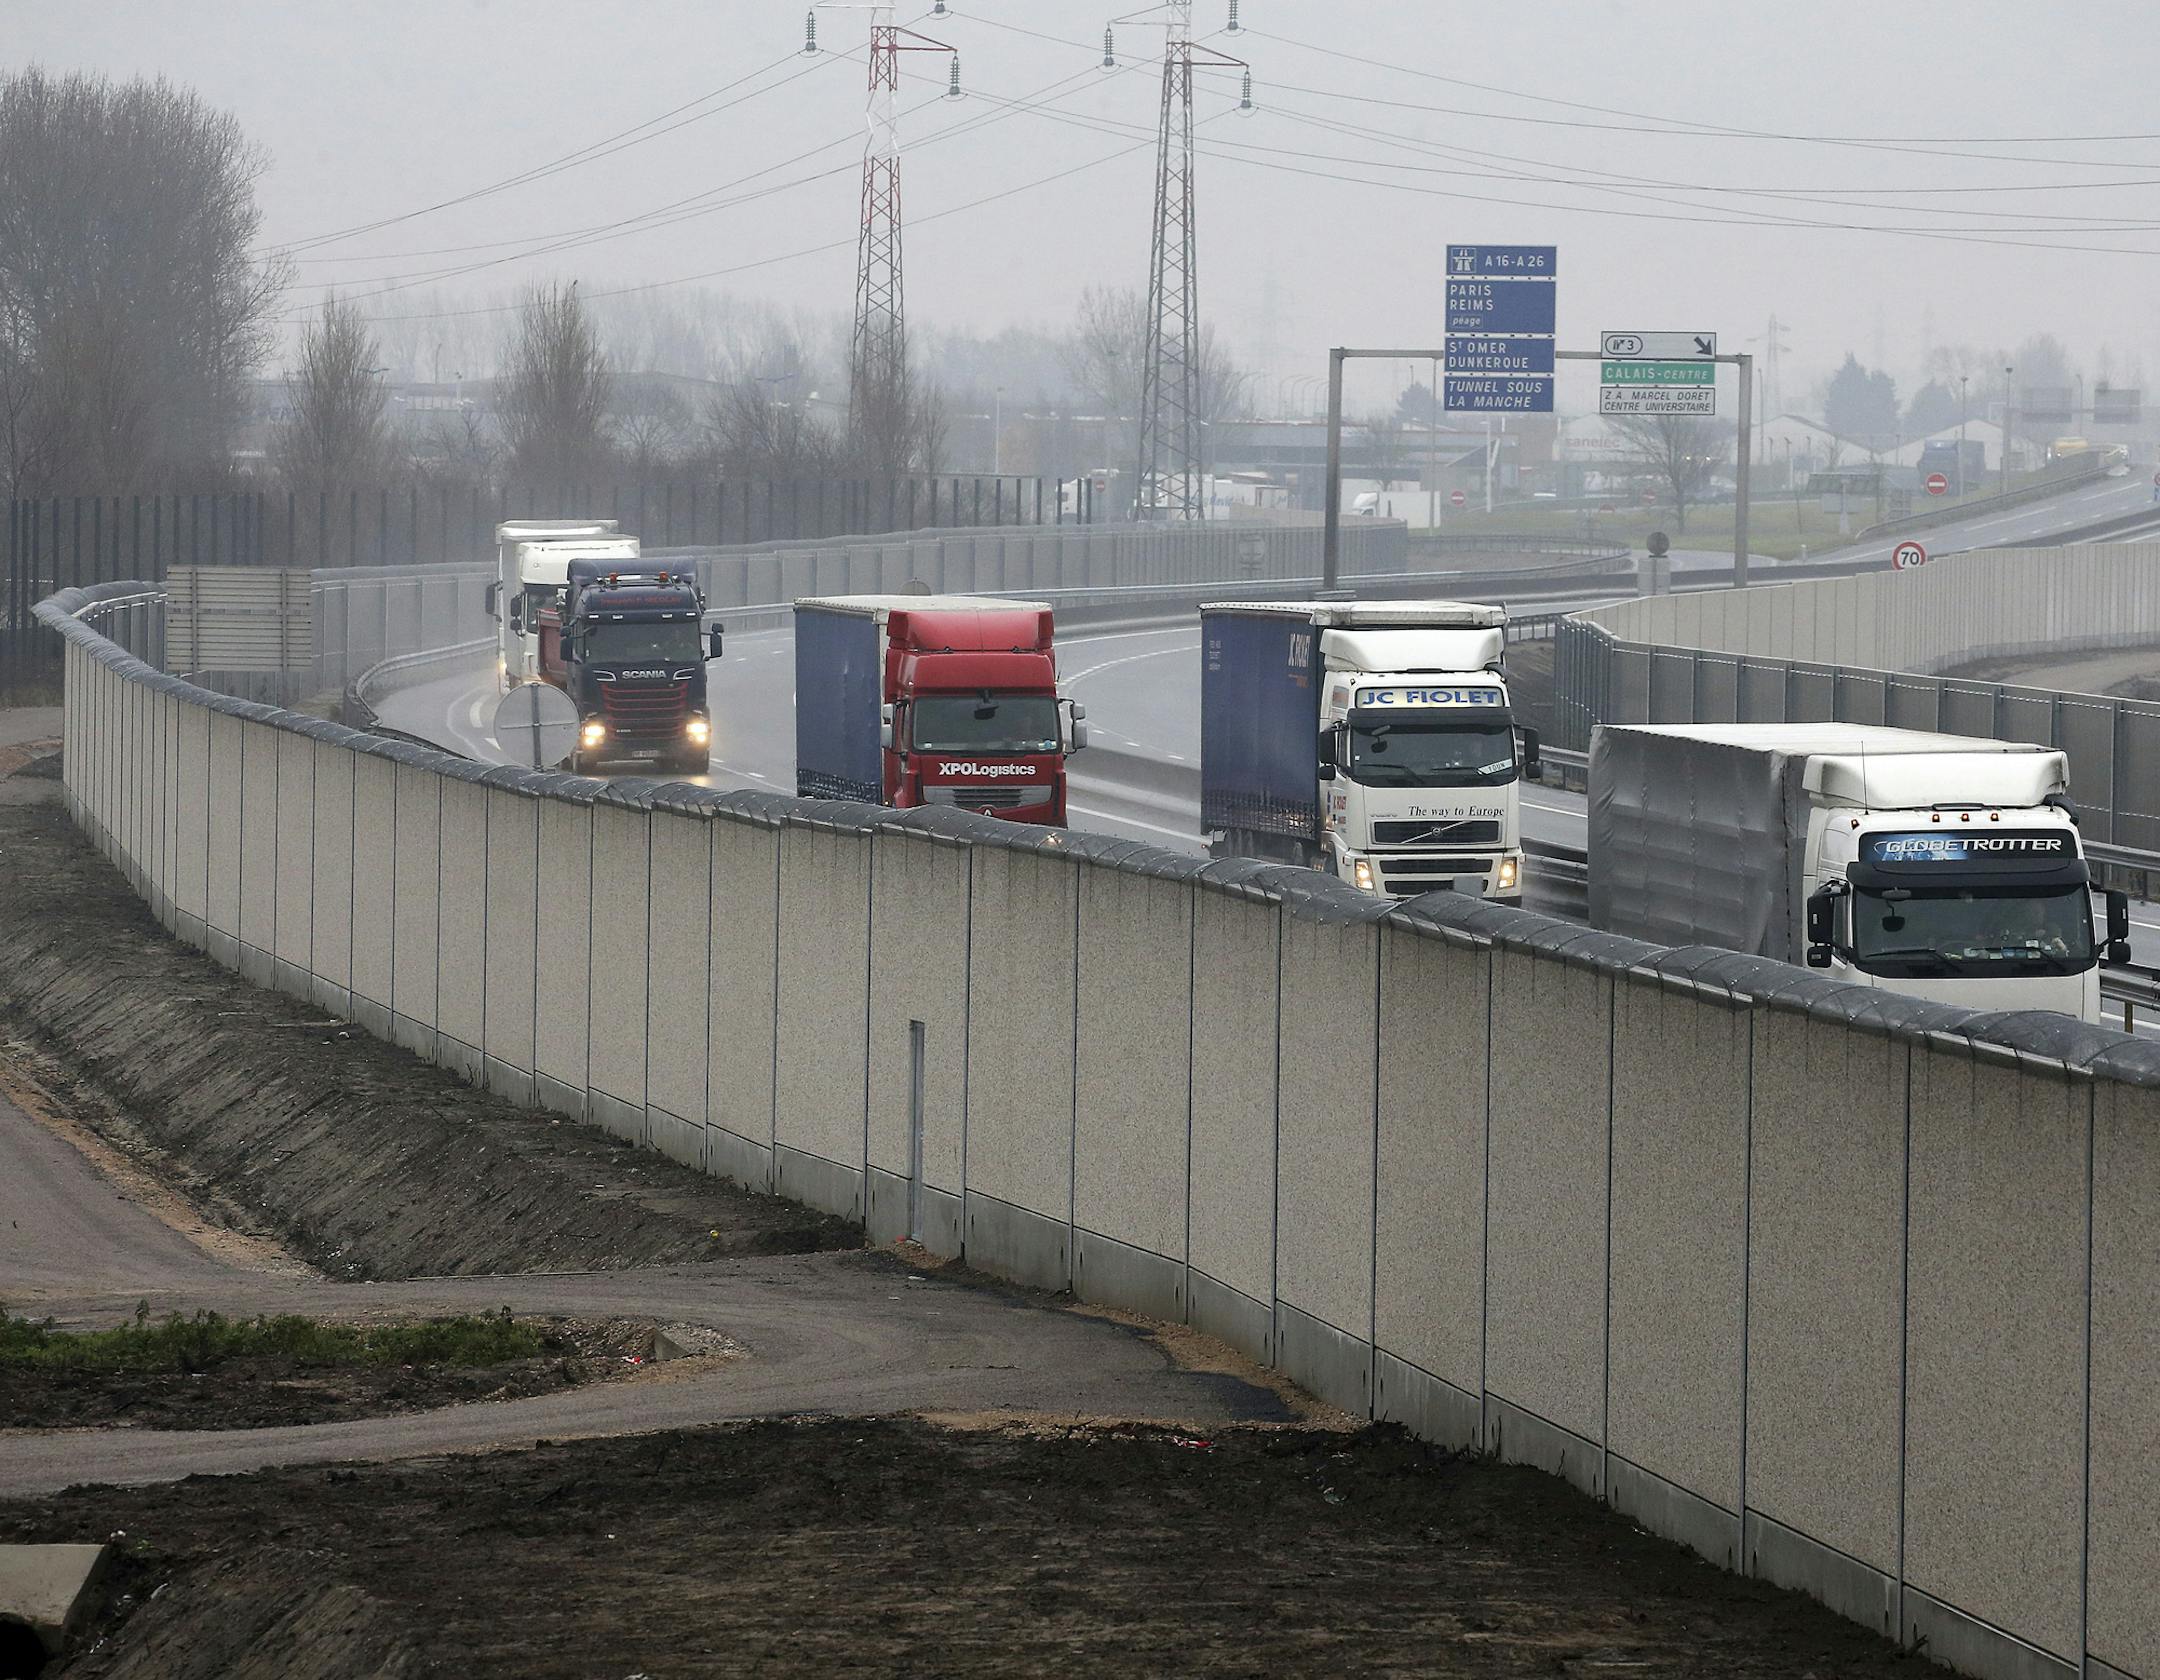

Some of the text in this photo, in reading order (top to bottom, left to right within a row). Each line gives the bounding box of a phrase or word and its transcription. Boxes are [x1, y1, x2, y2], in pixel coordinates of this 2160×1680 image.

[1450, 285, 1492, 296] PARIS
[1450, 300, 1494, 311] REIMS
[1467, 342, 1506, 354] OMER
[1449, 381, 1543, 393] TUNNEL SOUS
[1448, 396, 1531, 408] LA MANCHE
[1632, 391, 1671, 400] MARCEL
[1677, 392, 1710, 401] DORET
[1604, 402, 1711, 411] CENTRE UNIVERSITAIRE
[1901, 552, 1919, 565] 70
[622, 670, 667, 679] SCANIA
[1363, 691, 1497, 705] JC FIOLET
[1408, 805, 1427, 816] The
[1431, 808, 1450, 818] way
[1454, 807, 1464, 816] to
[1469, 805, 1505, 817] Europe
[1886, 838, 2062, 853] GLOBETROTTER
